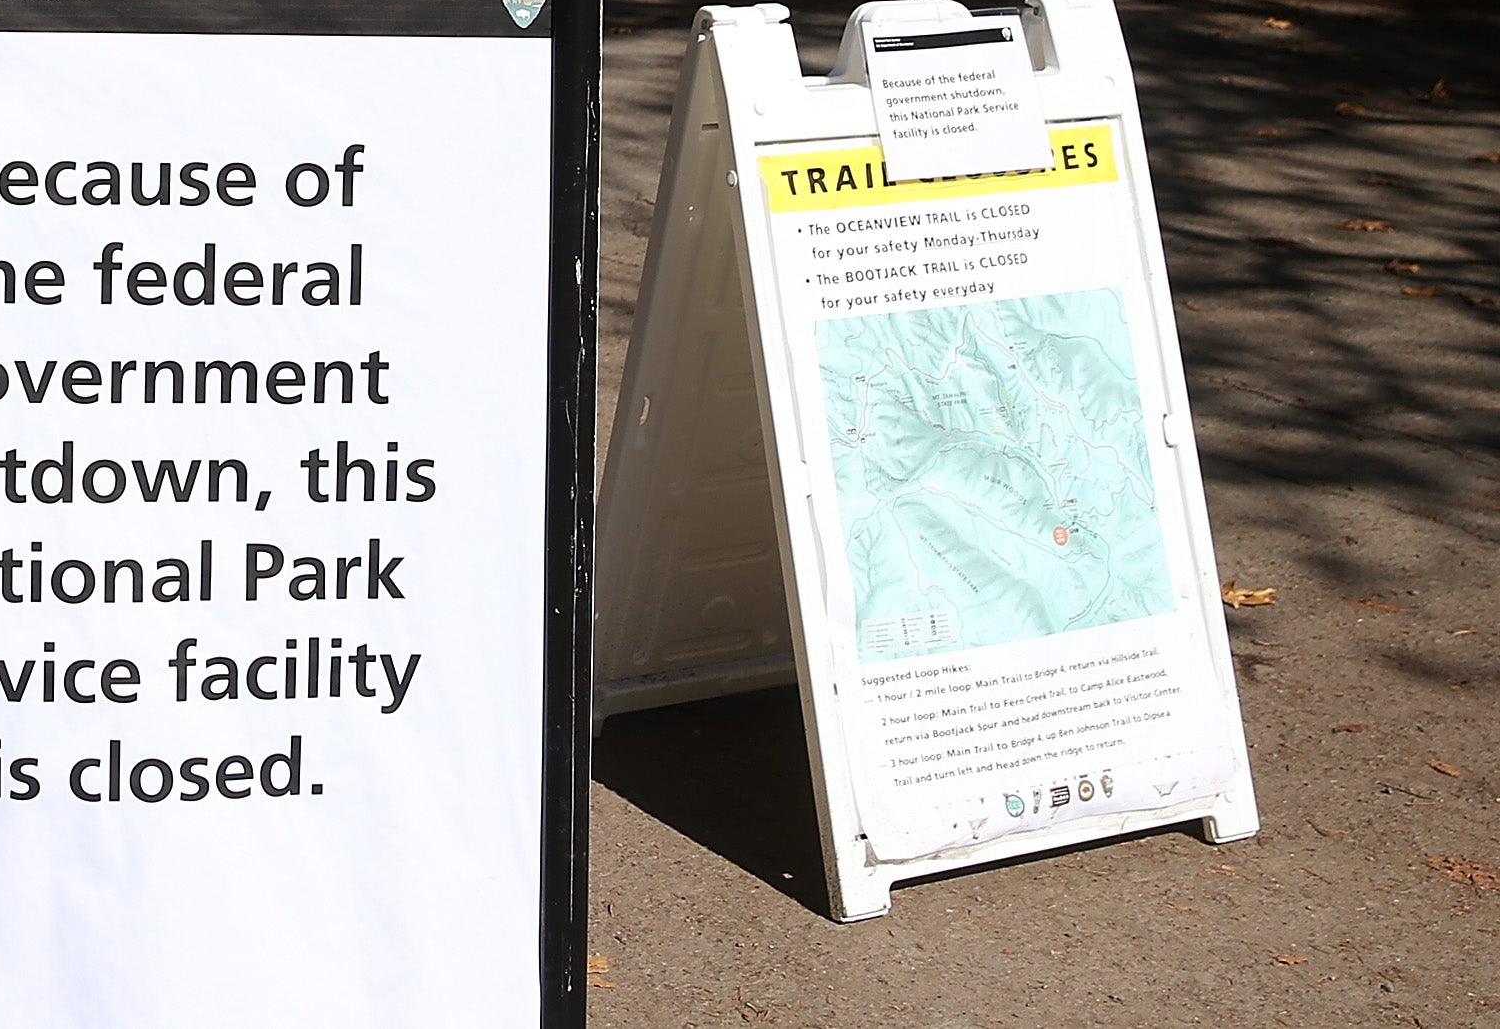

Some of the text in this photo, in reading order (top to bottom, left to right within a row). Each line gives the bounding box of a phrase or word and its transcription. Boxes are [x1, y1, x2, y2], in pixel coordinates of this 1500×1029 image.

[882, 70, 996, 89] Because of the federal
[886, 89, 1005, 107] government shutdown,
[890, 103, 1019, 122] this National Park Service
[893, 123, 978, 139] facility is closed.
[285, 144, 365, 207] of
[781, 162, 896, 195] TRAIL
[809, 204, 1030, 235] The OCEANVIEW TRAIL is CLOSED
[812, 227, 1040, 260] for your safety Monday-Thursday
[93, 243, 362, 306] federal
[817, 253, 1028, 285] The BOOTJACK TRAIL is CLOSED
[821, 282, 995, 310] for your safety everyday
[301, 441, 437, 503] this
[245, 539, 406, 601] Park
[169, 638, 421, 714] facility
[861, 664, 971, 686] Suggested Loop Hikes:
[885, 692, 907, 701] hour
[916, 690, 921, 698] 2
[925, 686, 946, 696] mile
[949, 683, 973, 693] loop:
[975, 679, 998, 688] Main
[1001, 674, 1022, 685] Trail
[1035, 665, 1057, 679] Bridge
[1069, 661, 1095, 670] return
[1098, 658, 1109, 666] via
[1111, 653, 1140, 663] Hillside
[882, 718, 887, 726] 2
[890, 715, 910, 724] hour
[914, 712, 938, 721] loop:
[941, 708, 966, 717] Main
[970, 703, 987, 712] Trail
[1004, 698, 1025, 707] Fern
[1026, 693, 1047, 704] Creek
[1069, 686, 1078, 694] to
[1081, 682, 1103, 693] Camp
[1106, 677, 1124, 687] Alice
[885, 735, 912, 745] return
[916, 732, 929, 740] via
[933, 724, 975, 738] Bootjack
[977, 721, 998, 732] Spur
[1002, 718, 1020, 727] and
[1022, 714, 1039, 724] head
[1041, 703, 1091, 718] downstream
[1094, 699, 1111, 709] back
[1124, 691, 1151, 702] Visitor
[1154, 686, 1182, 697] Center.
[891, 760, 896, 768] 3
[898, 757, 918, 766] hour
[921, 753, 945, 762] loop:
[947, 748, 971, 758] Main
[974, 743, 994, 753] Trail
[997, 742, 1008, 750] to
[1011, 735, 1035, 749] Bridge
[1046, 732, 1056, 741] up
[1058, 728, 1074, 737] Ben
[1076, 720, 1110, 733] Johnson
[1112, 716, 1131, 727] Trail
[1143, 710, 1170, 722] Dipsea
[70, 736, 323, 803] closed.
[894, 777, 912, 787] Trail
[915, 774, 932, 783] and
[934, 771, 955, 780] turn
[958, 767, 973, 776] left
[976, 763, 993, 773] and
[996, 760, 1020, 770] head
[1022, 755, 1042, 765] down
[1044, 750, 1058, 759] the
[1060, 747, 1082, 756] ridge
